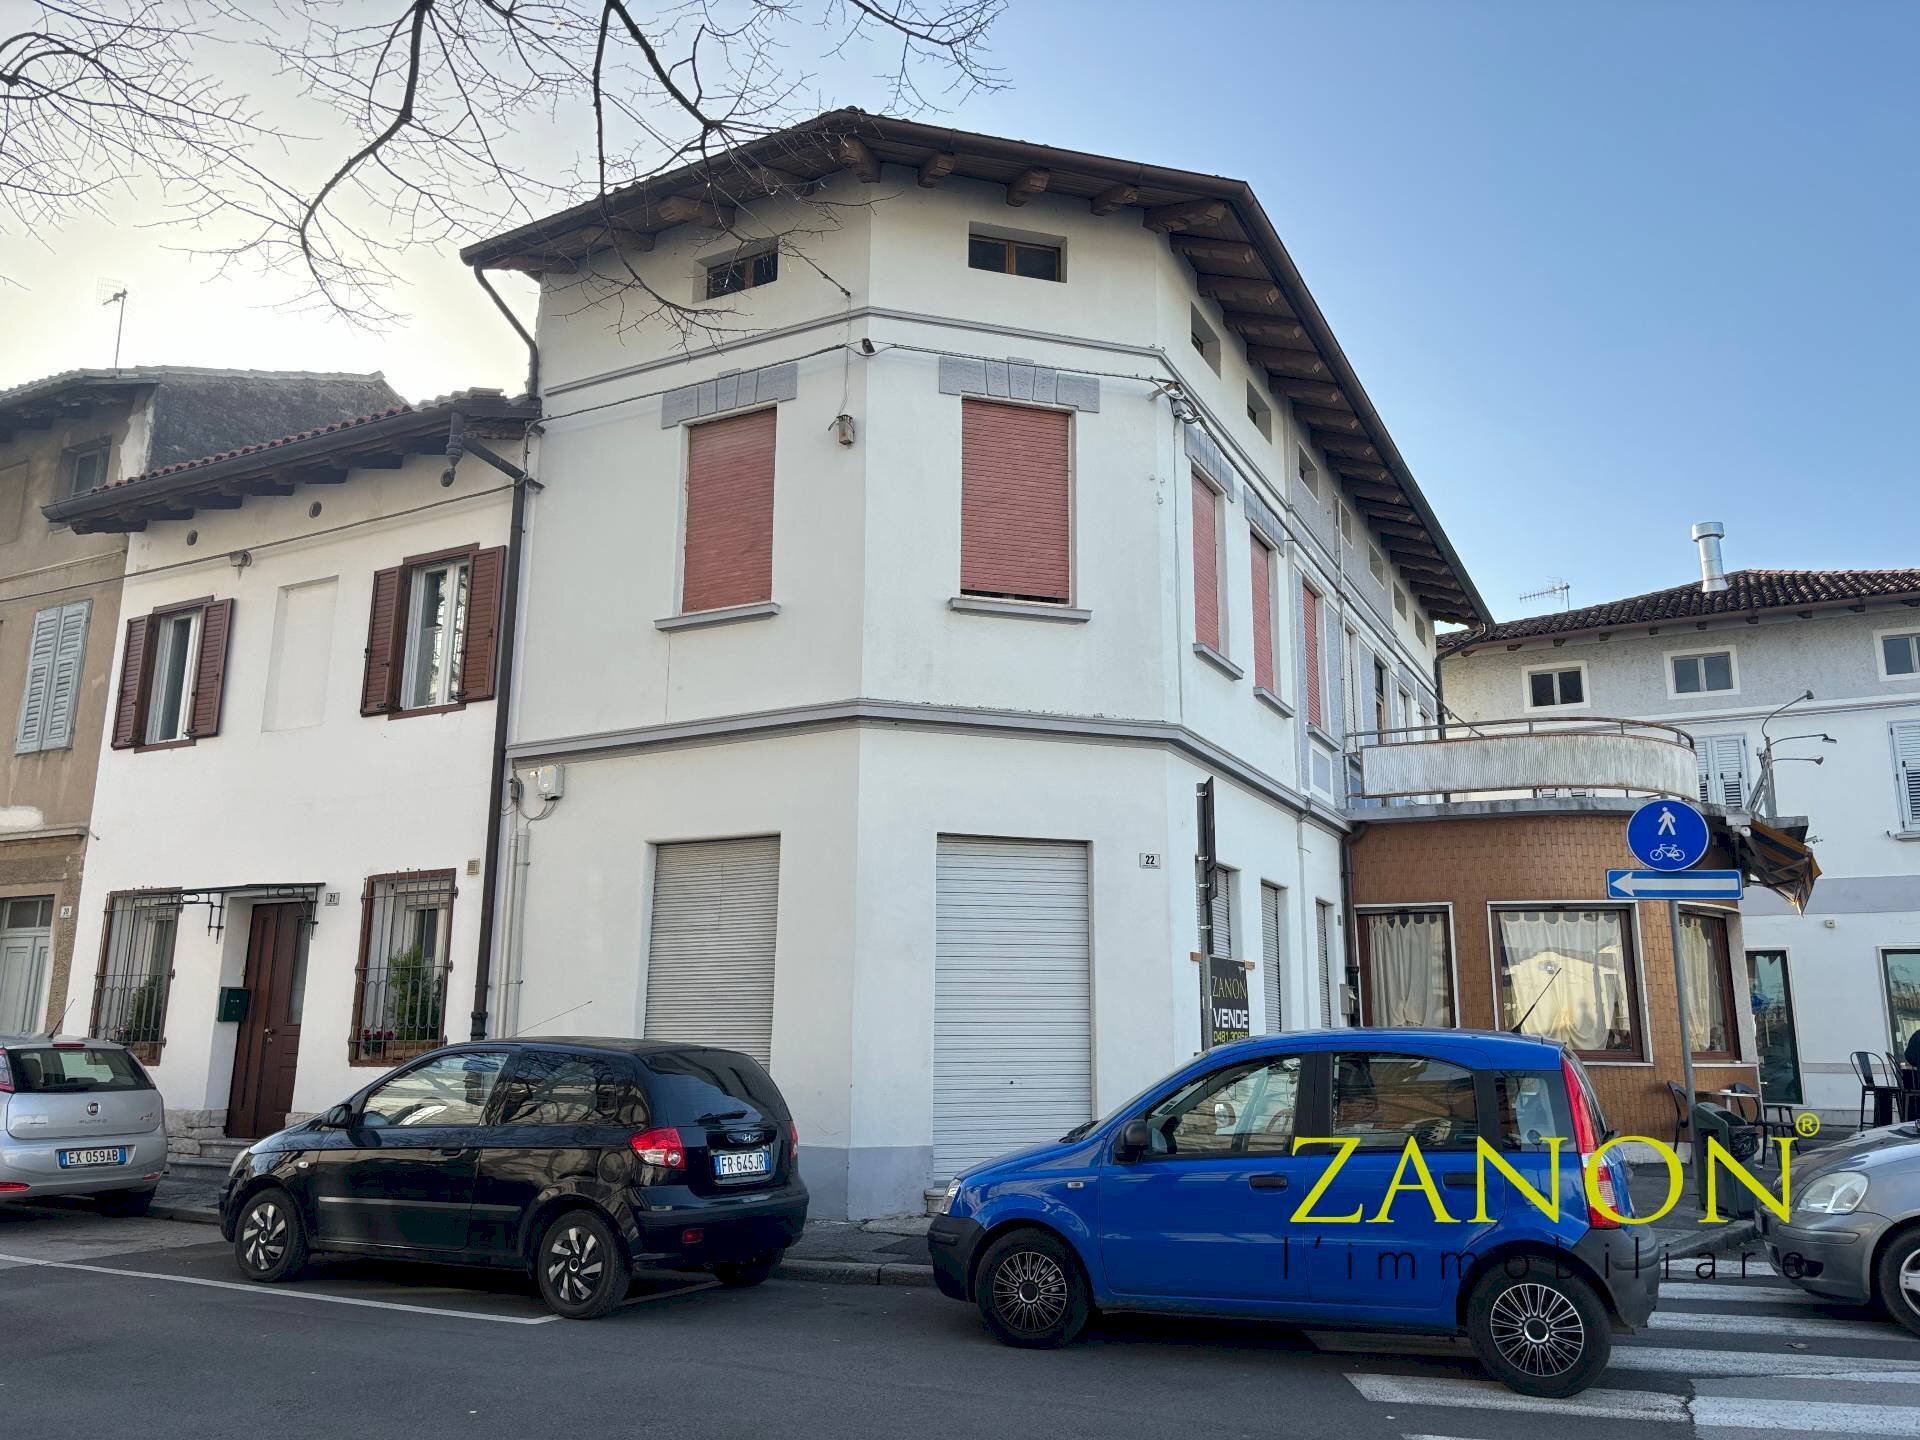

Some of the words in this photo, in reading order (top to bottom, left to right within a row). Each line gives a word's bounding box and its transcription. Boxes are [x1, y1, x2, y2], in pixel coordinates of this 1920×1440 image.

[1145, 855, 1155, 865] 22
[1211, 975, 1248, 1000] ZANON
[1212, 1007, 1249, 1029] VENDE
[68, 1152, 83, 1165] EX
[85, 1150, 119, 1163] 059AB
[721, 1156, 734, 1173] FR
[736, 1153, 765, 1172] 645JR
